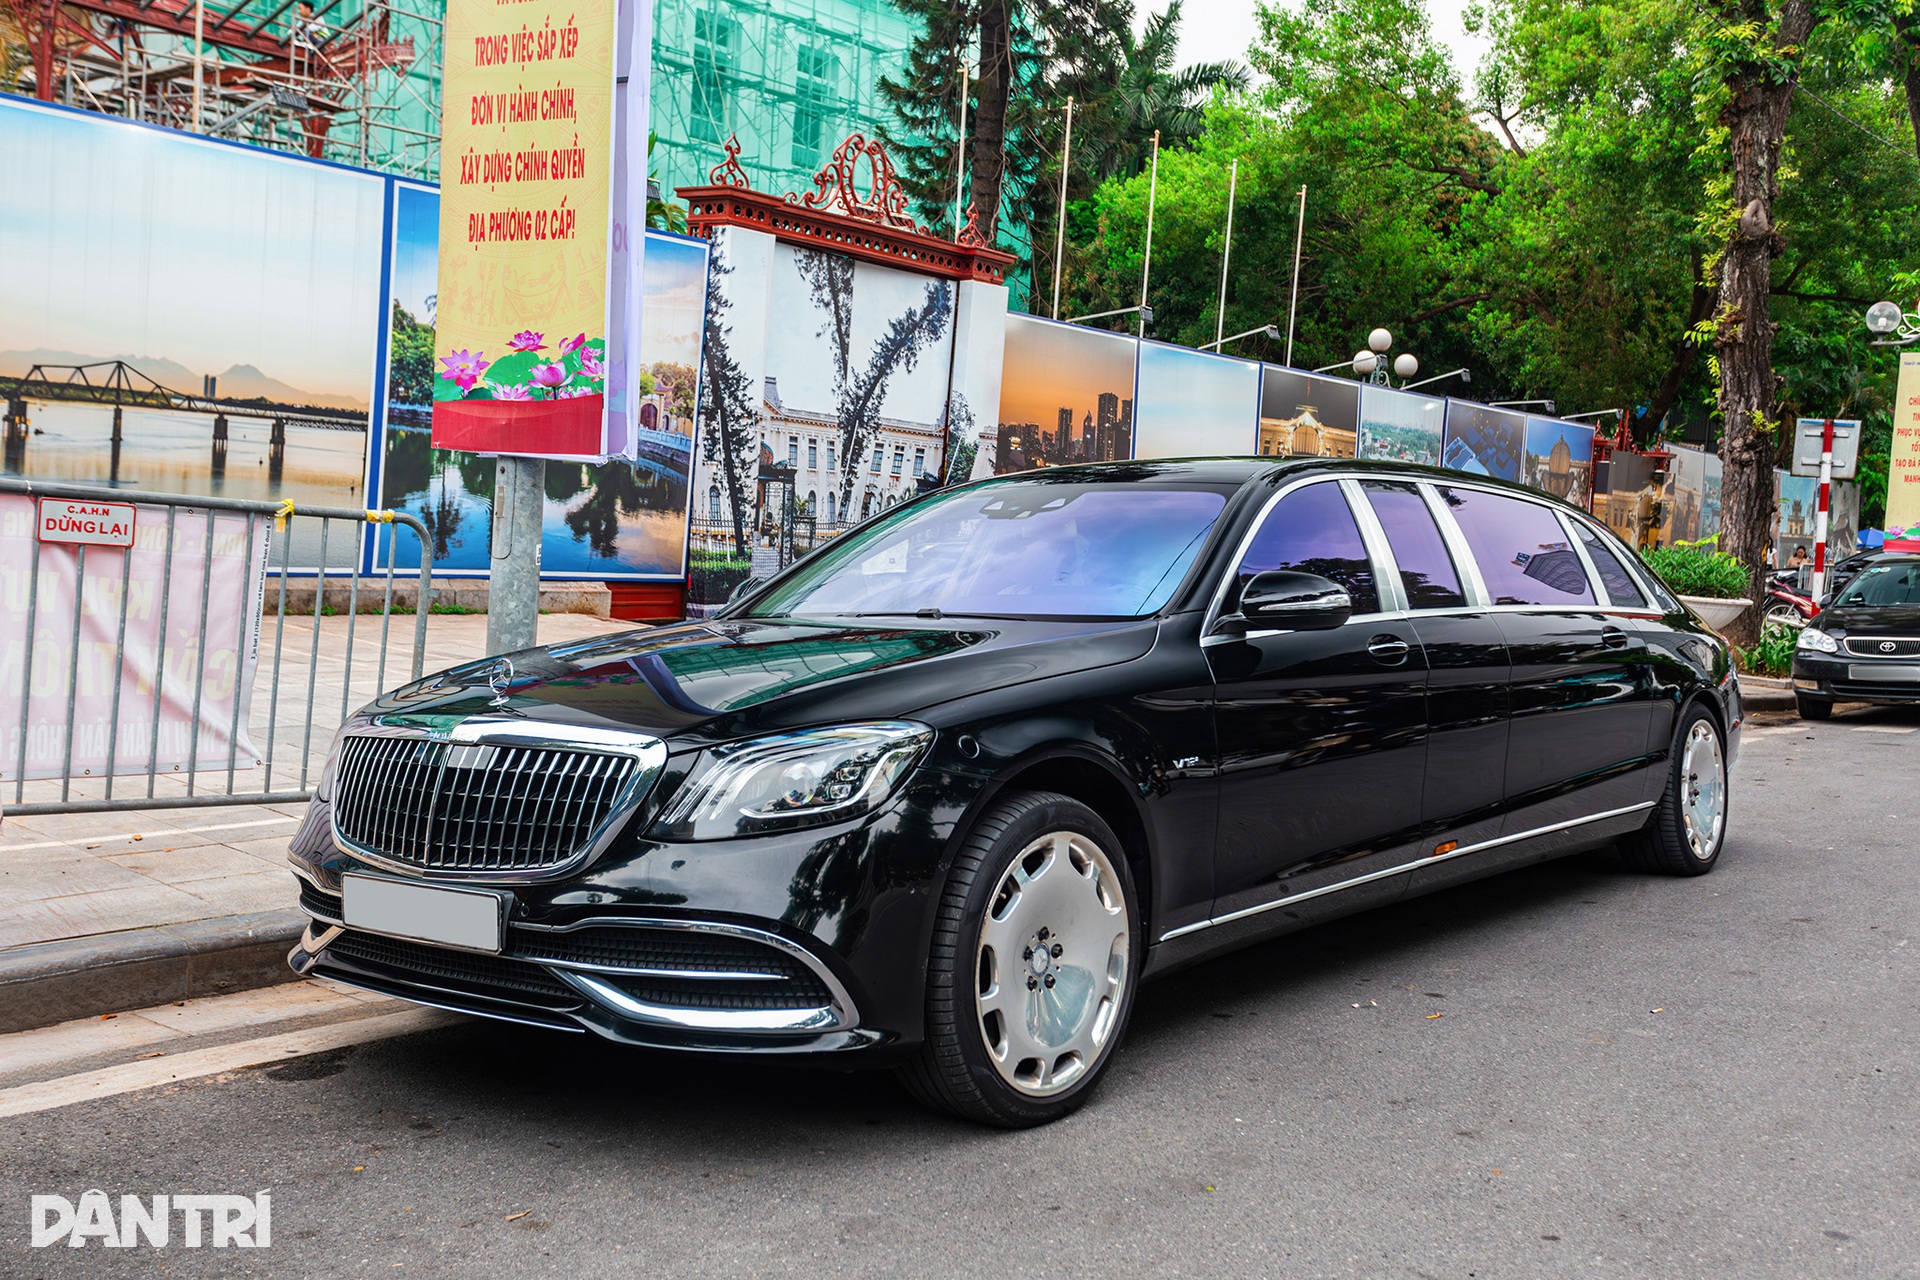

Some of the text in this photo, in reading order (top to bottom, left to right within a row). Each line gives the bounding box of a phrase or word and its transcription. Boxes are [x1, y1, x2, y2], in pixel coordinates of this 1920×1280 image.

[474, 13, 579, 72] TRONG VIỆC SẮP XẾP
[471, 80, 577, 133] ĐƠN VỊ HÀNH CHÍNH,
[459, 132, 585, 193] XÂY DỰNG CHÍNH QUYỀN
[468, 212, 486, 252] ĐỊA
[488, 207, 532, 242] PHƯƠNG
[534, 210, 548, 241] 02
[550, 194, 576, 240] CẤP!
[1911, 440, 1920, 452] TỐ
[45, 514, 96, 534] DỪNG
[99, 521, 128, 538] LẠI
[67, 505, 110, 516] C.A.H.N
